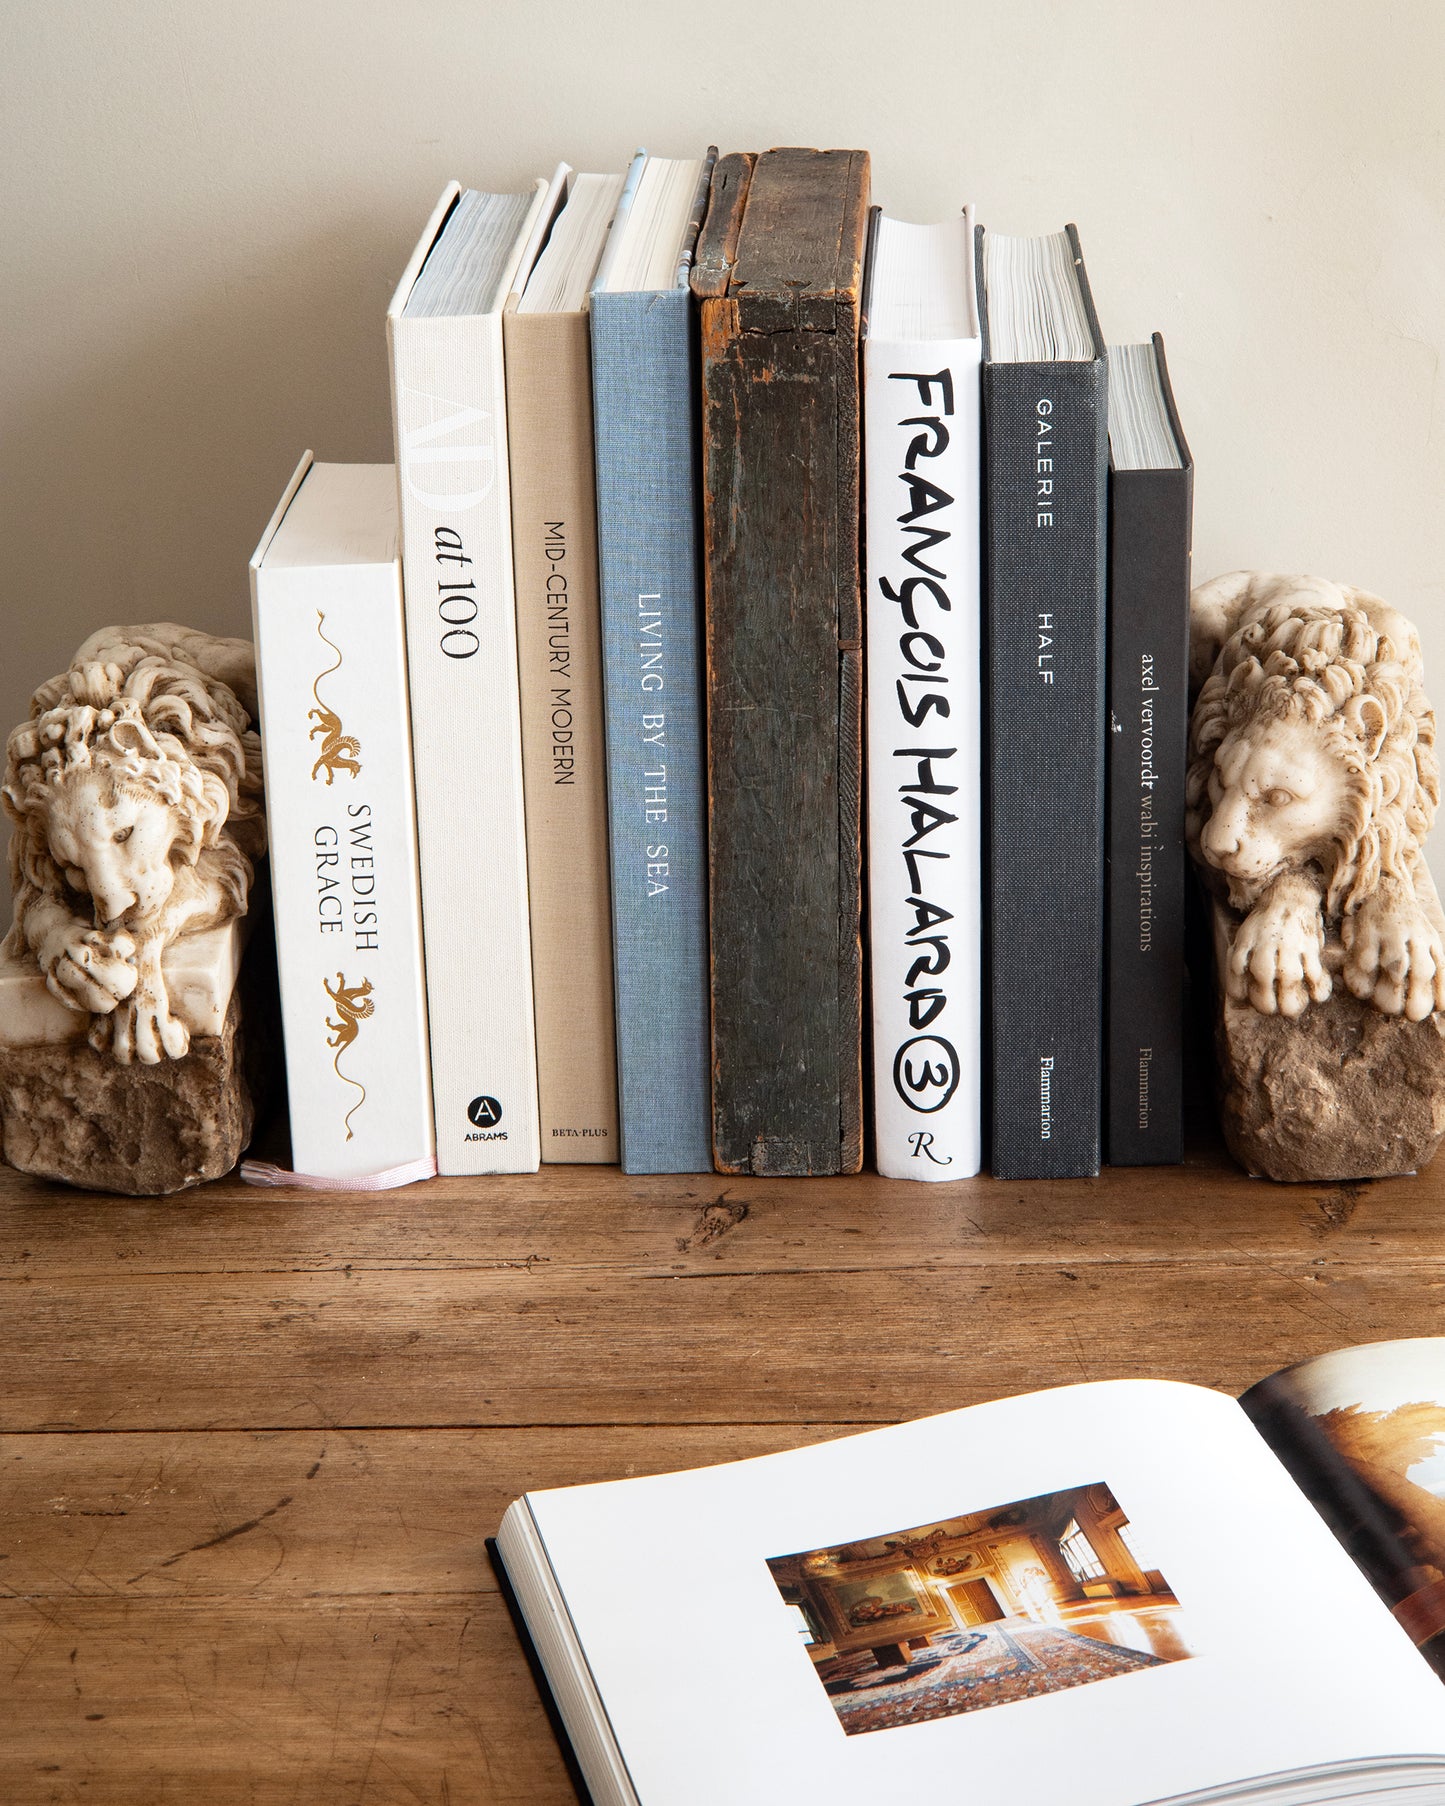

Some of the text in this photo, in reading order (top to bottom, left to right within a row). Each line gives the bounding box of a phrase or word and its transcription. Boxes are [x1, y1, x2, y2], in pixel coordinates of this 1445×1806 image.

[434, 526, 474, 568] at
[878, 367, 955, 729] FRANÇOIS
[1036, 398, 1054, 684] GALERIE HALF
[437, 578, 480, 660] 100
[543, 521, 575, 785] MID-CENTURY MODERN
[637, 592, 671, 898] LIVING BY THE SEA
[1136, 654, 1160, 952] axel vervoordt wabi inspirations
[314, 825, 343, 934] GRACE
[347, 804, 379, 952] SWEDISH
[892, 746, 960, 1031] HALARD
[464, 1131, 509, 1142] ABRAMS
[907, 1131, 953, 1166] R
[1040, 1056, 1054, 1140] Flammarion
[1138, 1048, 1153, 1129] Flammarion
